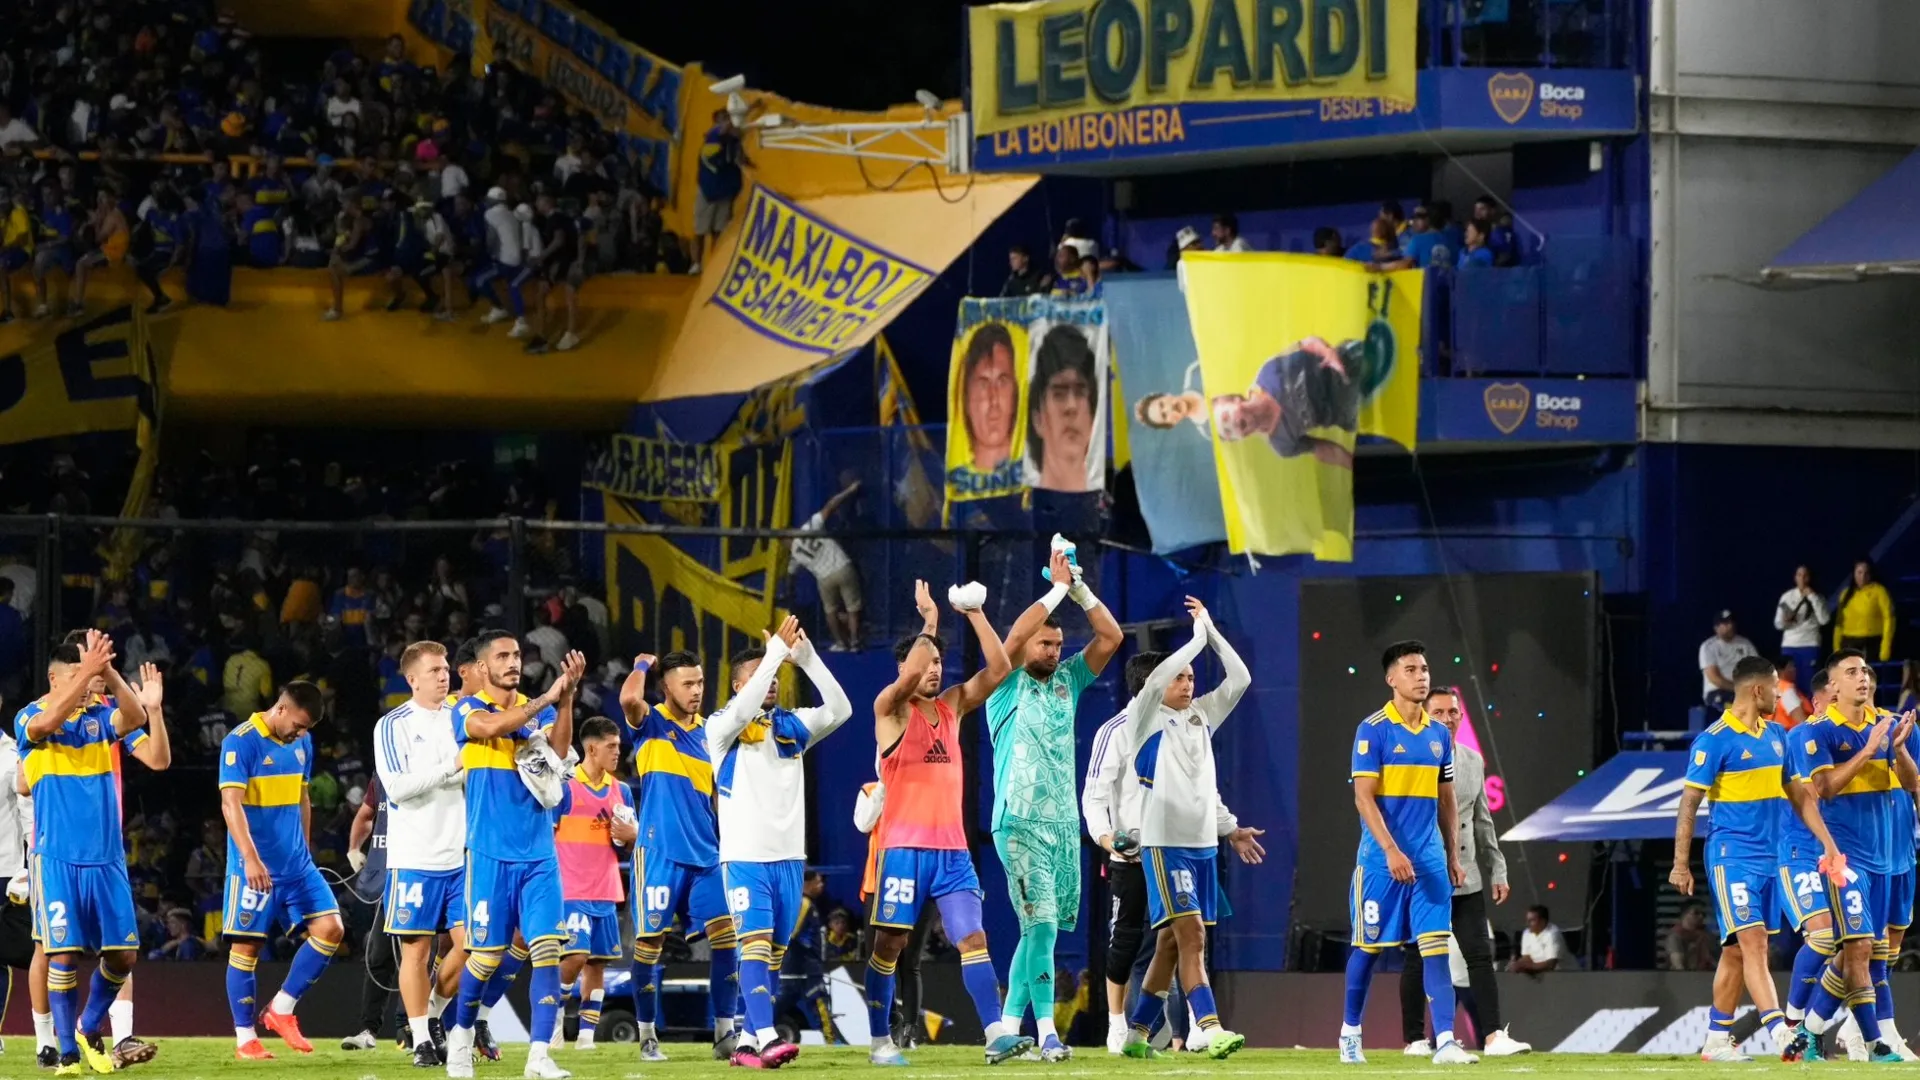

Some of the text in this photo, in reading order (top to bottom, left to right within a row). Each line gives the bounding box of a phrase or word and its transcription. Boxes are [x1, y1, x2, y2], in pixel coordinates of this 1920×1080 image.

[996, 0, 1388, 113] LEOPARDI
[1540, 83, 1585, 100] Boca
[1320, 98, 1373, 122] DESDE
[1540, 101, 1582, 121] Shop
[994, 107, 1185, 157] LA BOMBONERA
[1536, 393, 1581, 410] Boca
[1536, 411, 1578, 430] Shop
[923, 753, 951, 764] adidas
[398, 882, 423, 908] 14
[884, 877, 915, 904] 25
[1730, 882, 1748, 906] 5
[1794, 871, 1824, 897] 28
[241, 886, 270, 912] 57
[646, 886, 670, 910] 10
[728, 887, 750, 914] 18
[1845, 890, 1863, 915] 3
[49, 901, 67, 927] 2
[473, 900, 489, 927] 4
[566, 912, 591, 936] 44
[1364, 899, 1379, 924] 8
